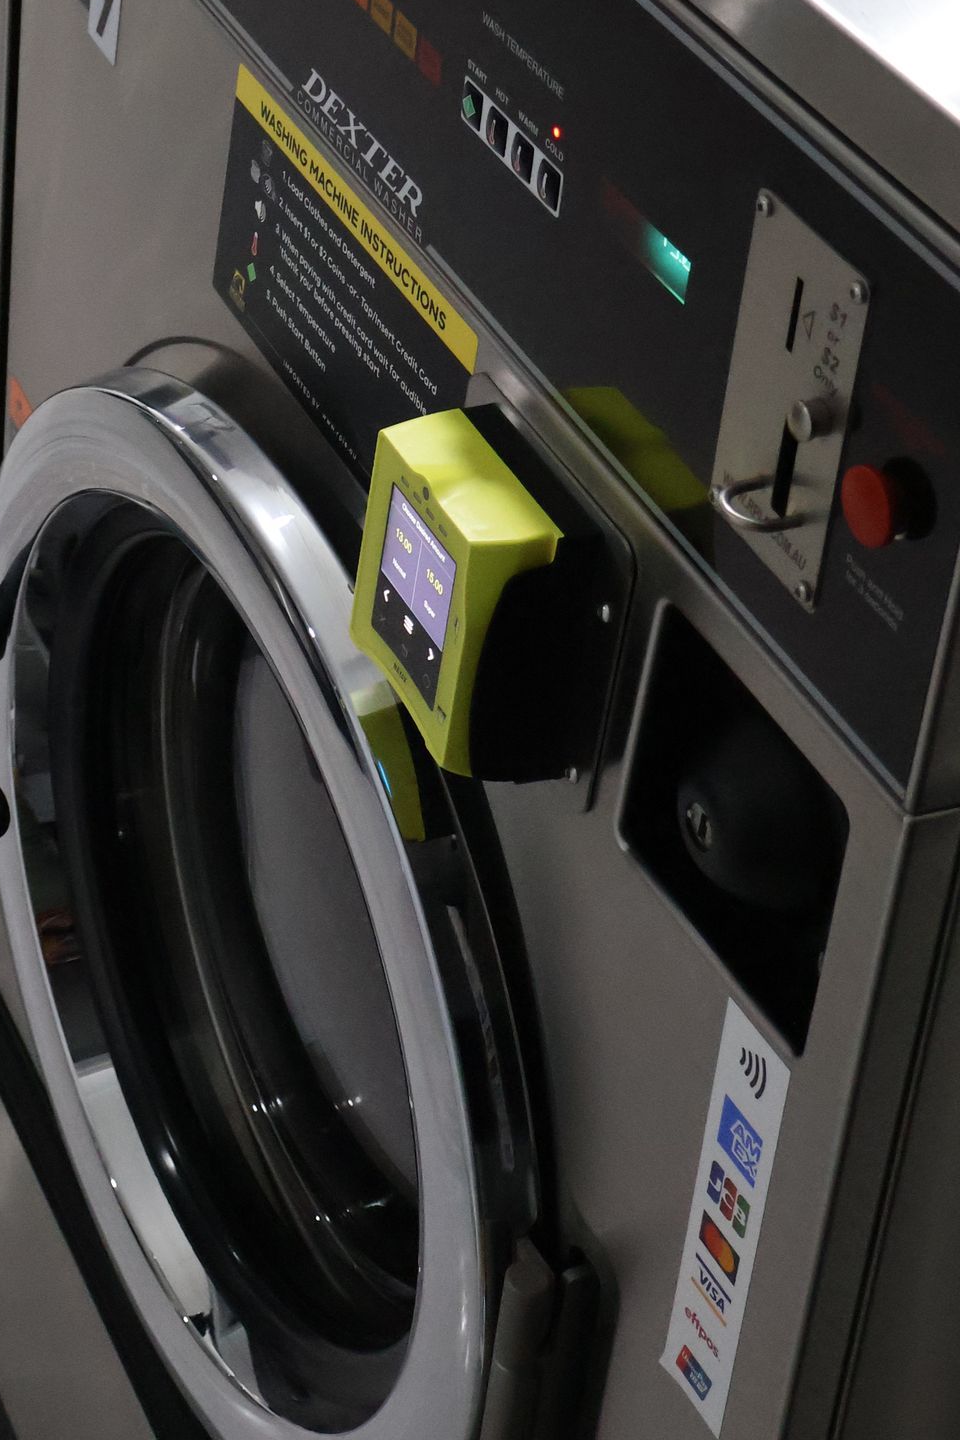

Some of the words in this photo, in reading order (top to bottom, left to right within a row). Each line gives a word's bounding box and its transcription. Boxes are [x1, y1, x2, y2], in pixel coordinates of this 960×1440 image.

[467, 58, 488, 85] START
[482, 10, 505, 42] WASH
[505, 33, 565, 100] TEMPERATURE
[494, 87, 509, 106] HOT
[518, 110, 539, 137] WARM
[296, 89, 368, 183] COMMERCIAL
[374, 177, 423, 244] WASHER
[301, 67, 423, 218] DEXTER
[544, 137, 564, 163] COLD
[260, 100, 308, 167] WASHING
[309, 159, 360, 228] MACHINE
[360, 218, 447, 331] INSTRUCTIONS
[287, 175, 304, 202] Load
[303, 196, 328, 233] Clothes
[328, 228, 342, 248] and
[342, 242, 376, 289] Detergent
[271, 296, 288, 323] Push
[287, 316, 305, 345] Start
[304, 338, 327, 374] Button
[275, 272, 295, 303] Select
[296, 296, 336, 354] Temperature
[281, 228, 299, 258] When
[299, 254, 322, 288] paying
[321, 281, 337, 306] with
[336, 300, 357, 330] credit
[356, 325, 373, 350] card
[373, 345, 389, 370] wait
[389, 364, 400, 382] for
[400, 379, 427, 416] audible
[284, 204, 304, 233] Insert
[310, 237, 318, 251] or
[318, 245, 327, 262] $2
[327, 256, 346, 285] Coins
[360, 295, 396, 345] Tap/Insert
[395, 340, 418, 373] Credit
[418, 367, 438, 396] Card
[313, 287, 335, 320] before
[334, 316, 363, 358] pressing
[362, 351, 380, 378] start
[395, 527, 413, 555] 13.00
[425, 567, 444, 596] 15.00
[699, 1266, 726, 1314] VISA
[684, 1305, 720, 1359] eftpos
